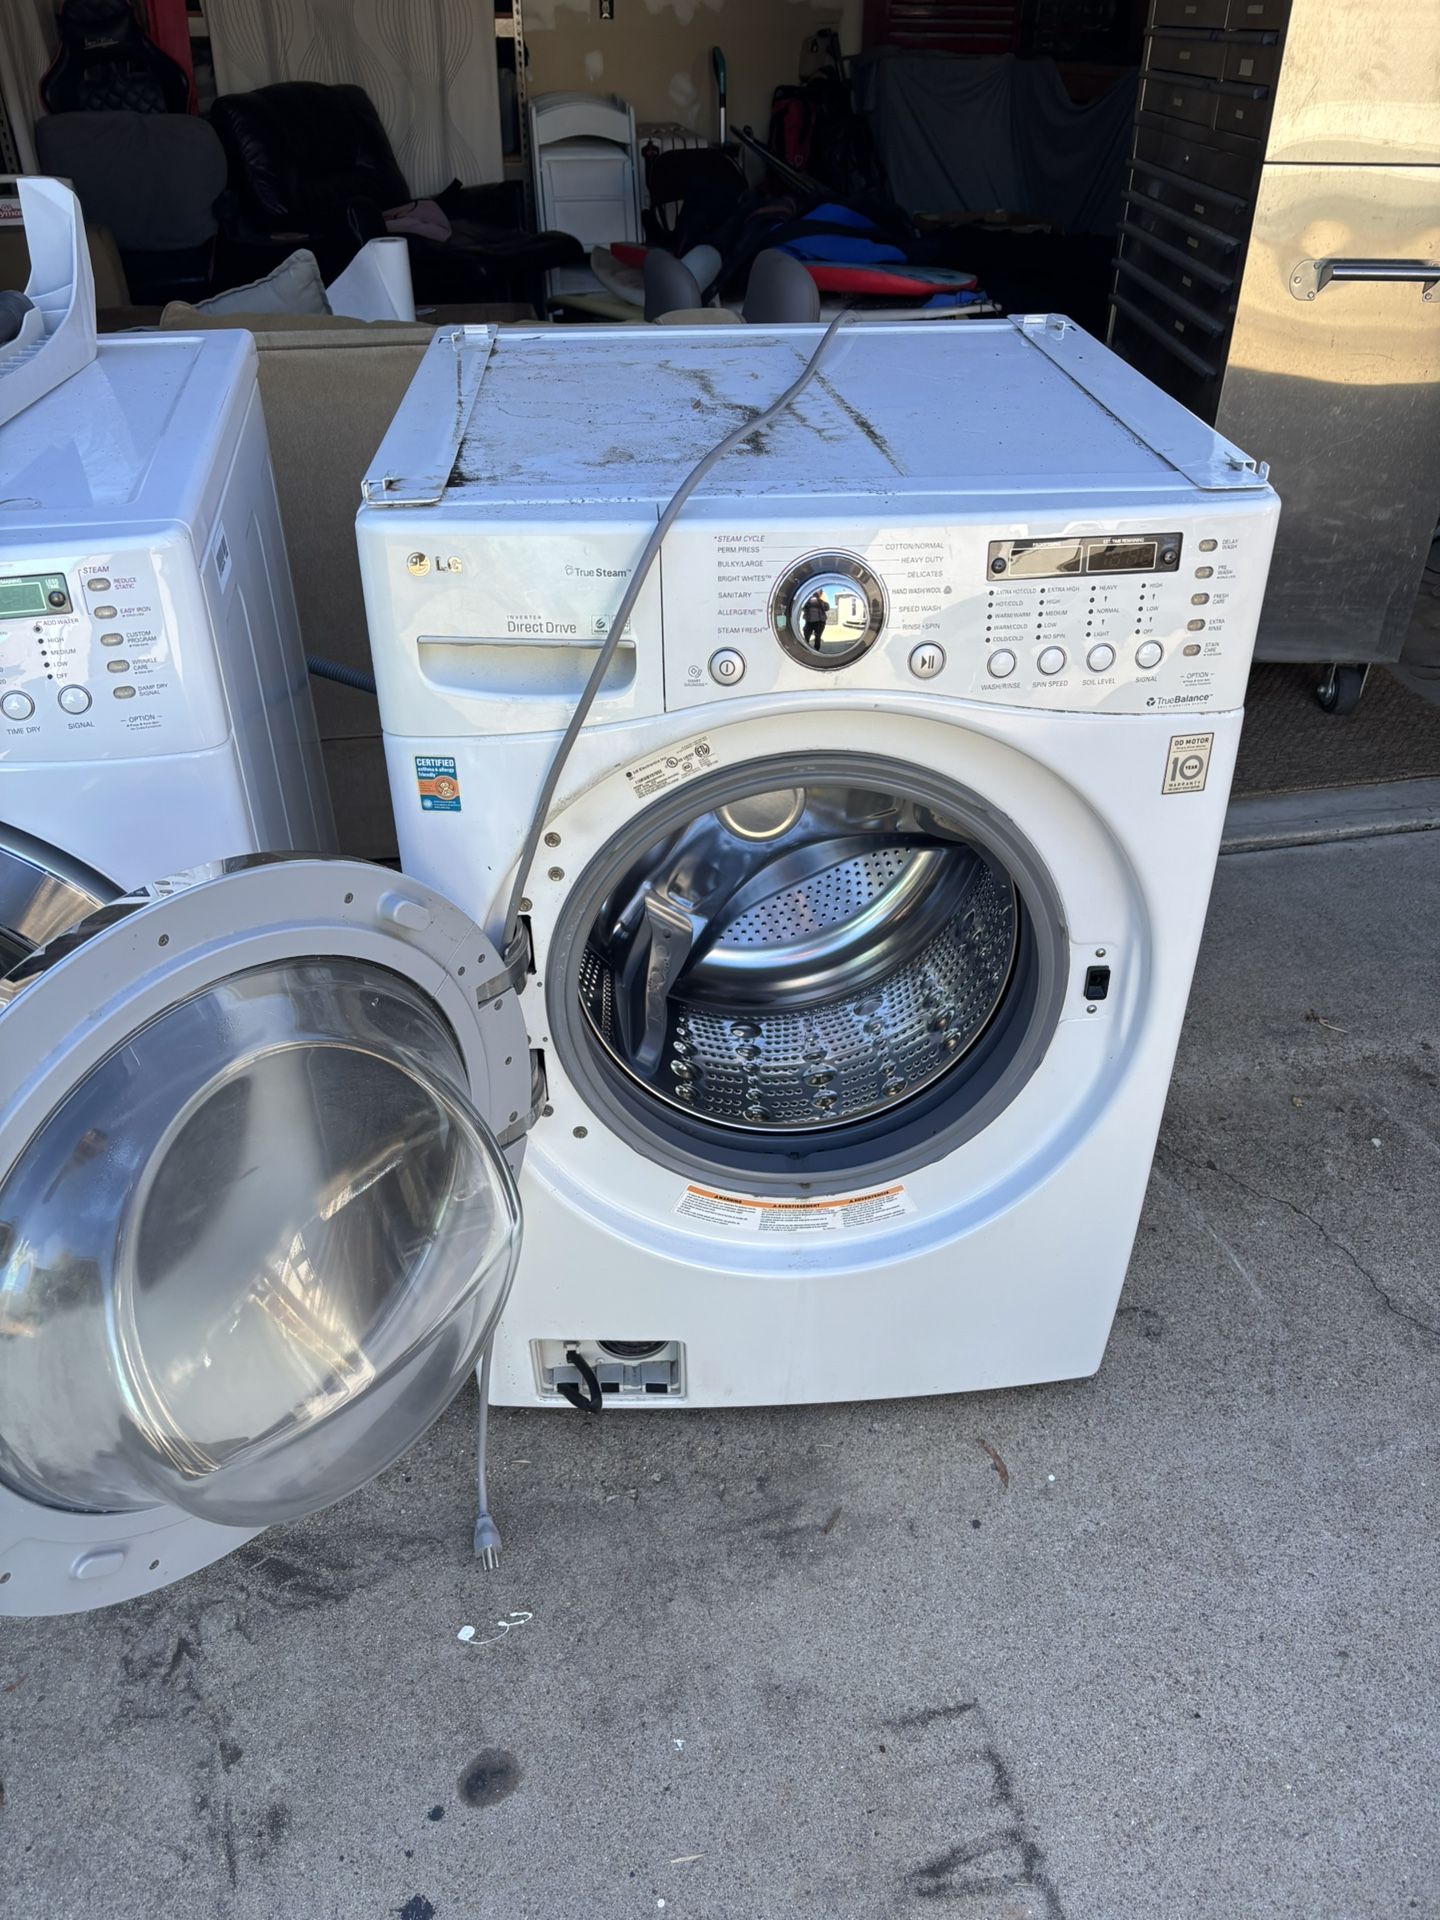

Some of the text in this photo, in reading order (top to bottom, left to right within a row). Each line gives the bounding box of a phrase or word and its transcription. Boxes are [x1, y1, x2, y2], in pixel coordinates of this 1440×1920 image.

[743, 535, 766, 543] CYCLE
[435, 555, 462, 573] LG
[718, 560, 764, 568] BULKY/LARGE
[901, 556, 924, 564] HEAVY
[83, 566, 110, 574] STEAM
[507, 620, 577, 634] Direct Drive
[126, 630, 152, 638] CUSTOM
[127, 636, 157, 644] PROGRAM
[50, 648, 76, 656] MEDIUM
[1135, 676, 1158, 684] SIGNAL
[1186, 672, 1210, 680] OPTION
[1048, 680, 1069, 688] SPEED
[128, 714, 156, 723] OPTION
[68, 721, 96, 730] SIGNAL
[6, 726, 41, 736] TIME DRY
[1186, 737, 1210, 745] MOTOR
[416, 758, 454, 767] CERTIFIED
[1170, 754, 1204, 782] 10
